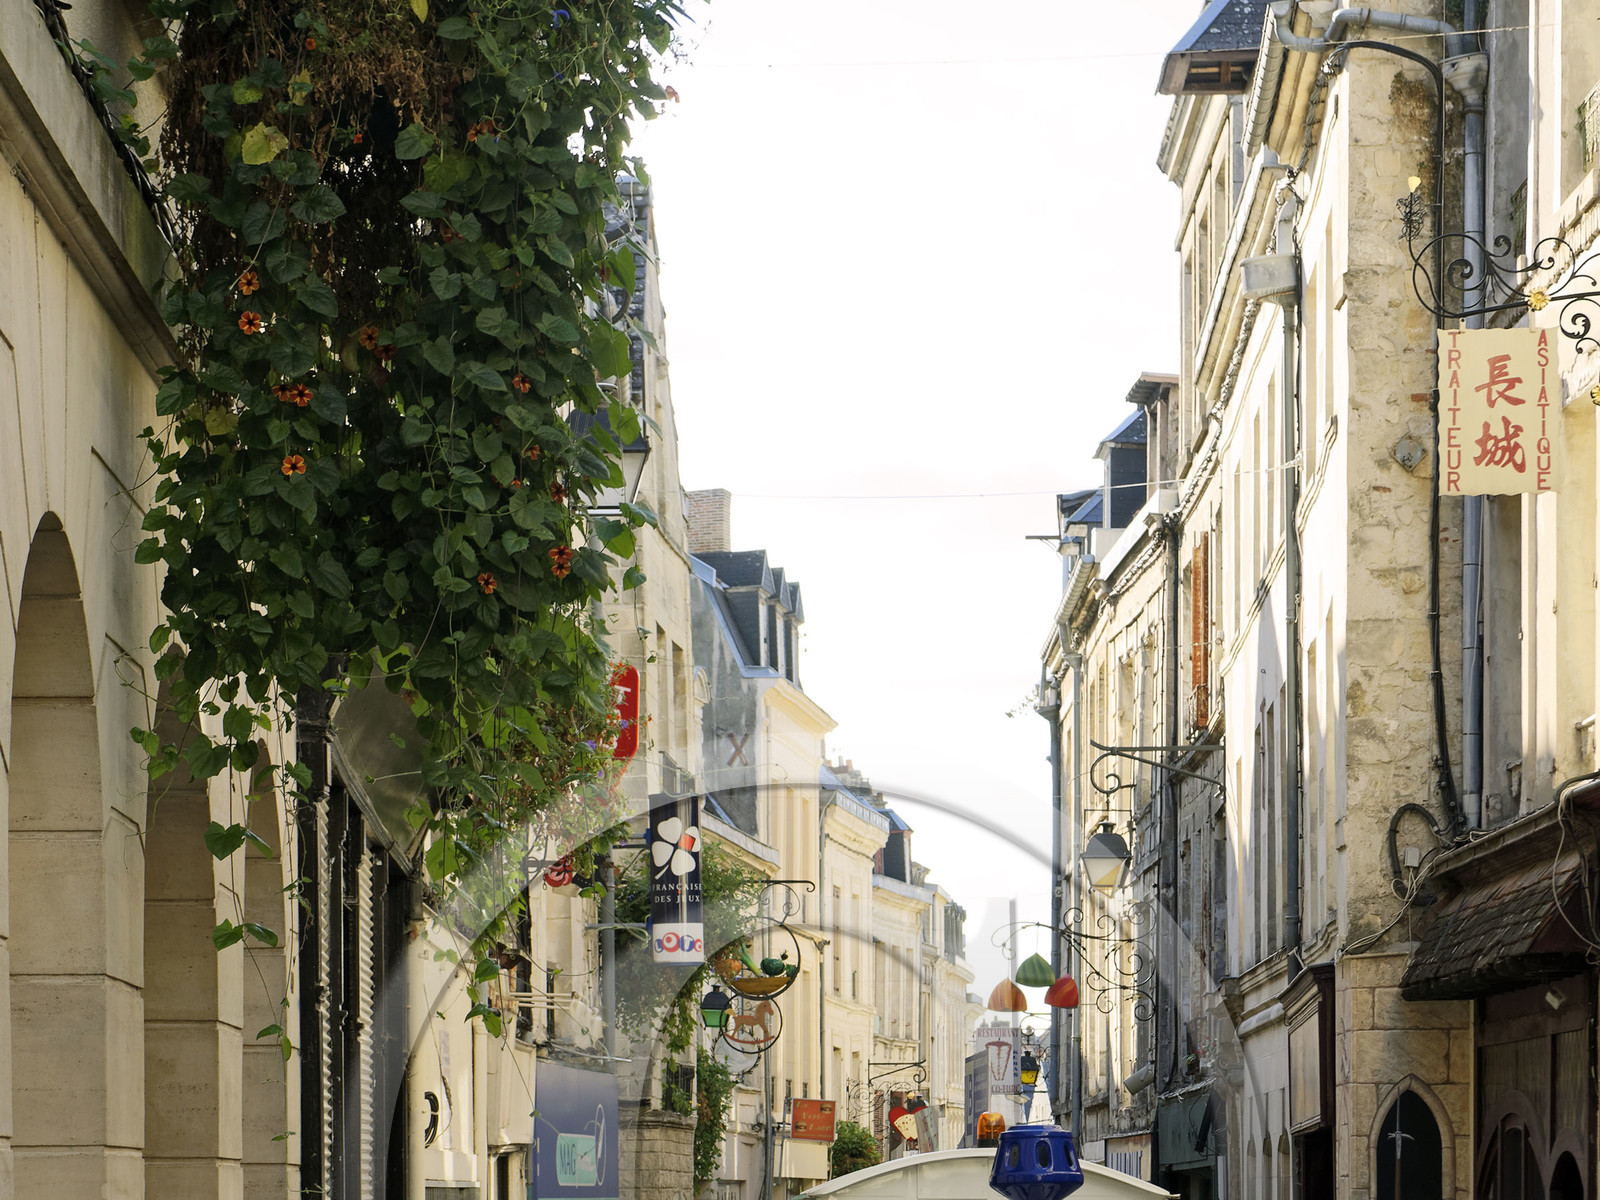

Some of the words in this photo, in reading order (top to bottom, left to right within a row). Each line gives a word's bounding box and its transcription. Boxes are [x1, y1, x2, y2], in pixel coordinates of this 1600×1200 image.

[1447, 332, 1462, 492] TRAITEUR
[1473, 354, 1526, 474] 長城
[1537, 329, 1551, 491] ASIATIQUE
[653, 883, 702, 893] FRANÇAISE
[655, 895, 671, 903] DES
[676, 895, 700, 904] JEUX
[977, 1028, 1018, 1037] RESTAURANT
[559, 1143, 576, 1176] MAG
